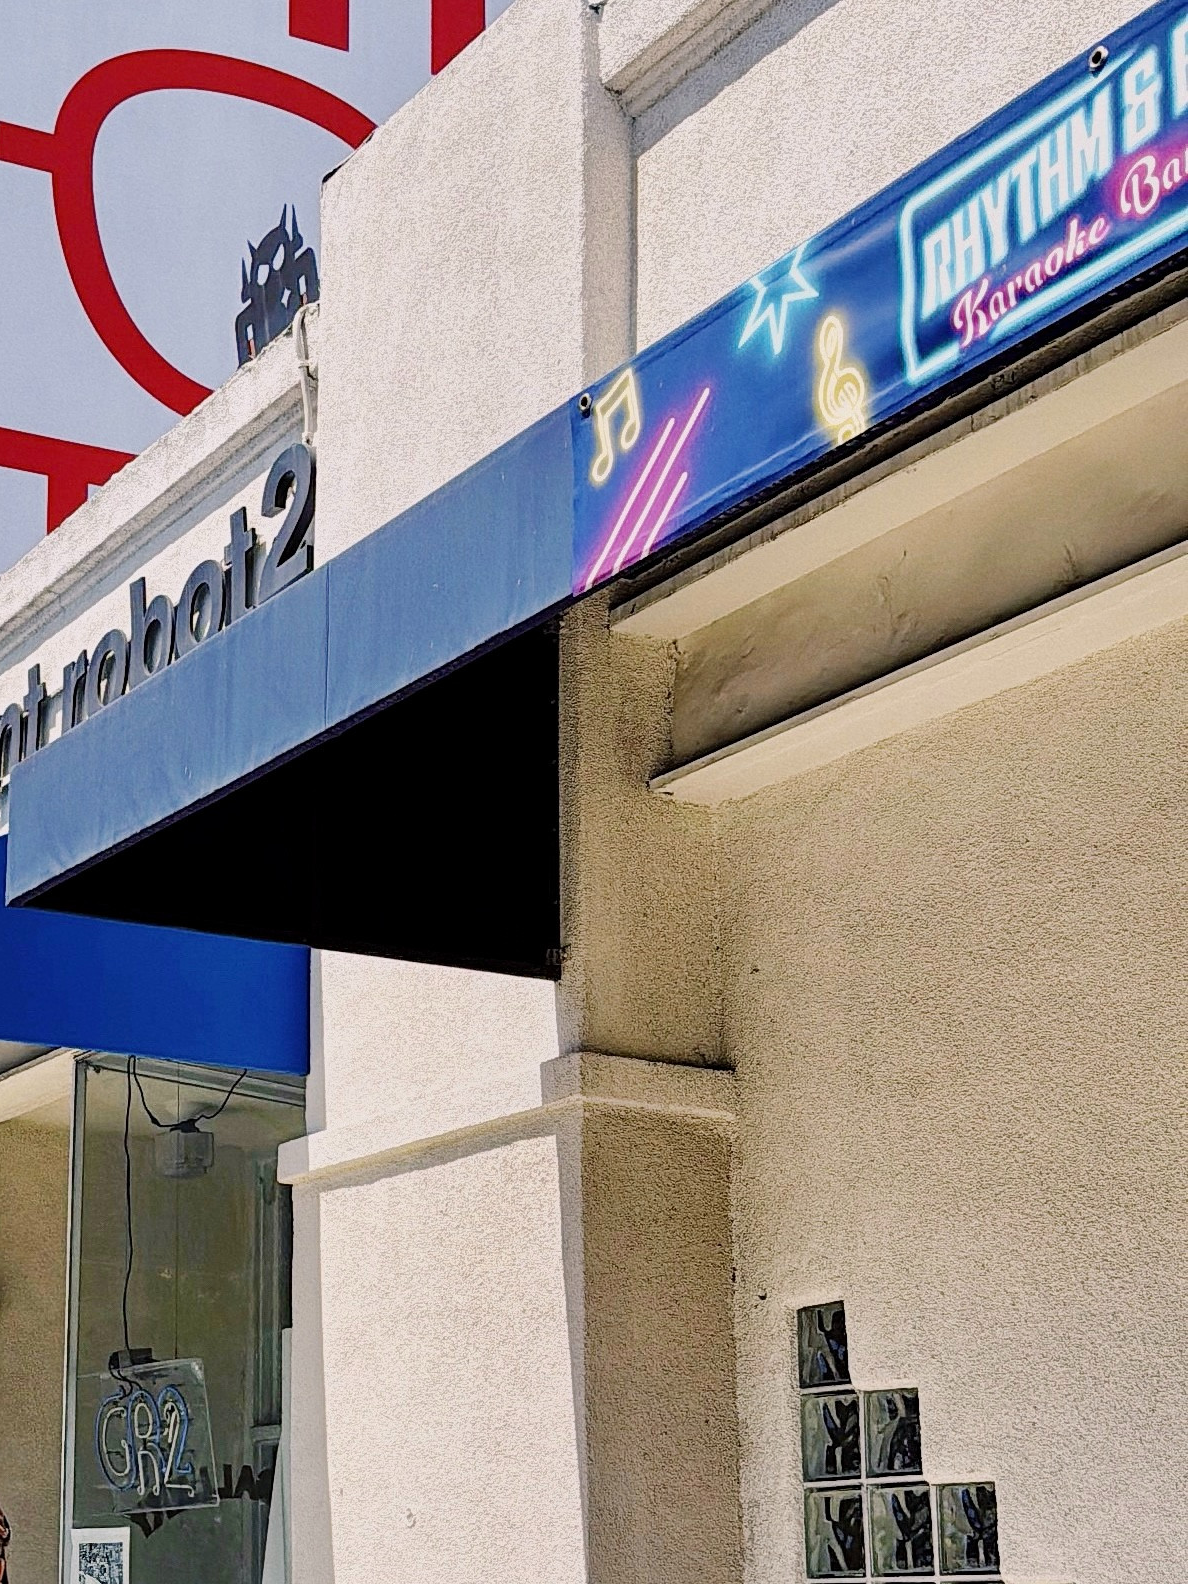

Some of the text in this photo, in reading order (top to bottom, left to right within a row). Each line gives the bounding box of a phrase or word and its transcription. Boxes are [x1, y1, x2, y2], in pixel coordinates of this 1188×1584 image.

[921, 82, 1112, 320] RHYTHM
[1123, 48, 1158, 151] &
[952, 215, 1110, 347] Karaoke
[94, 1384, 195, 1498] GR2
